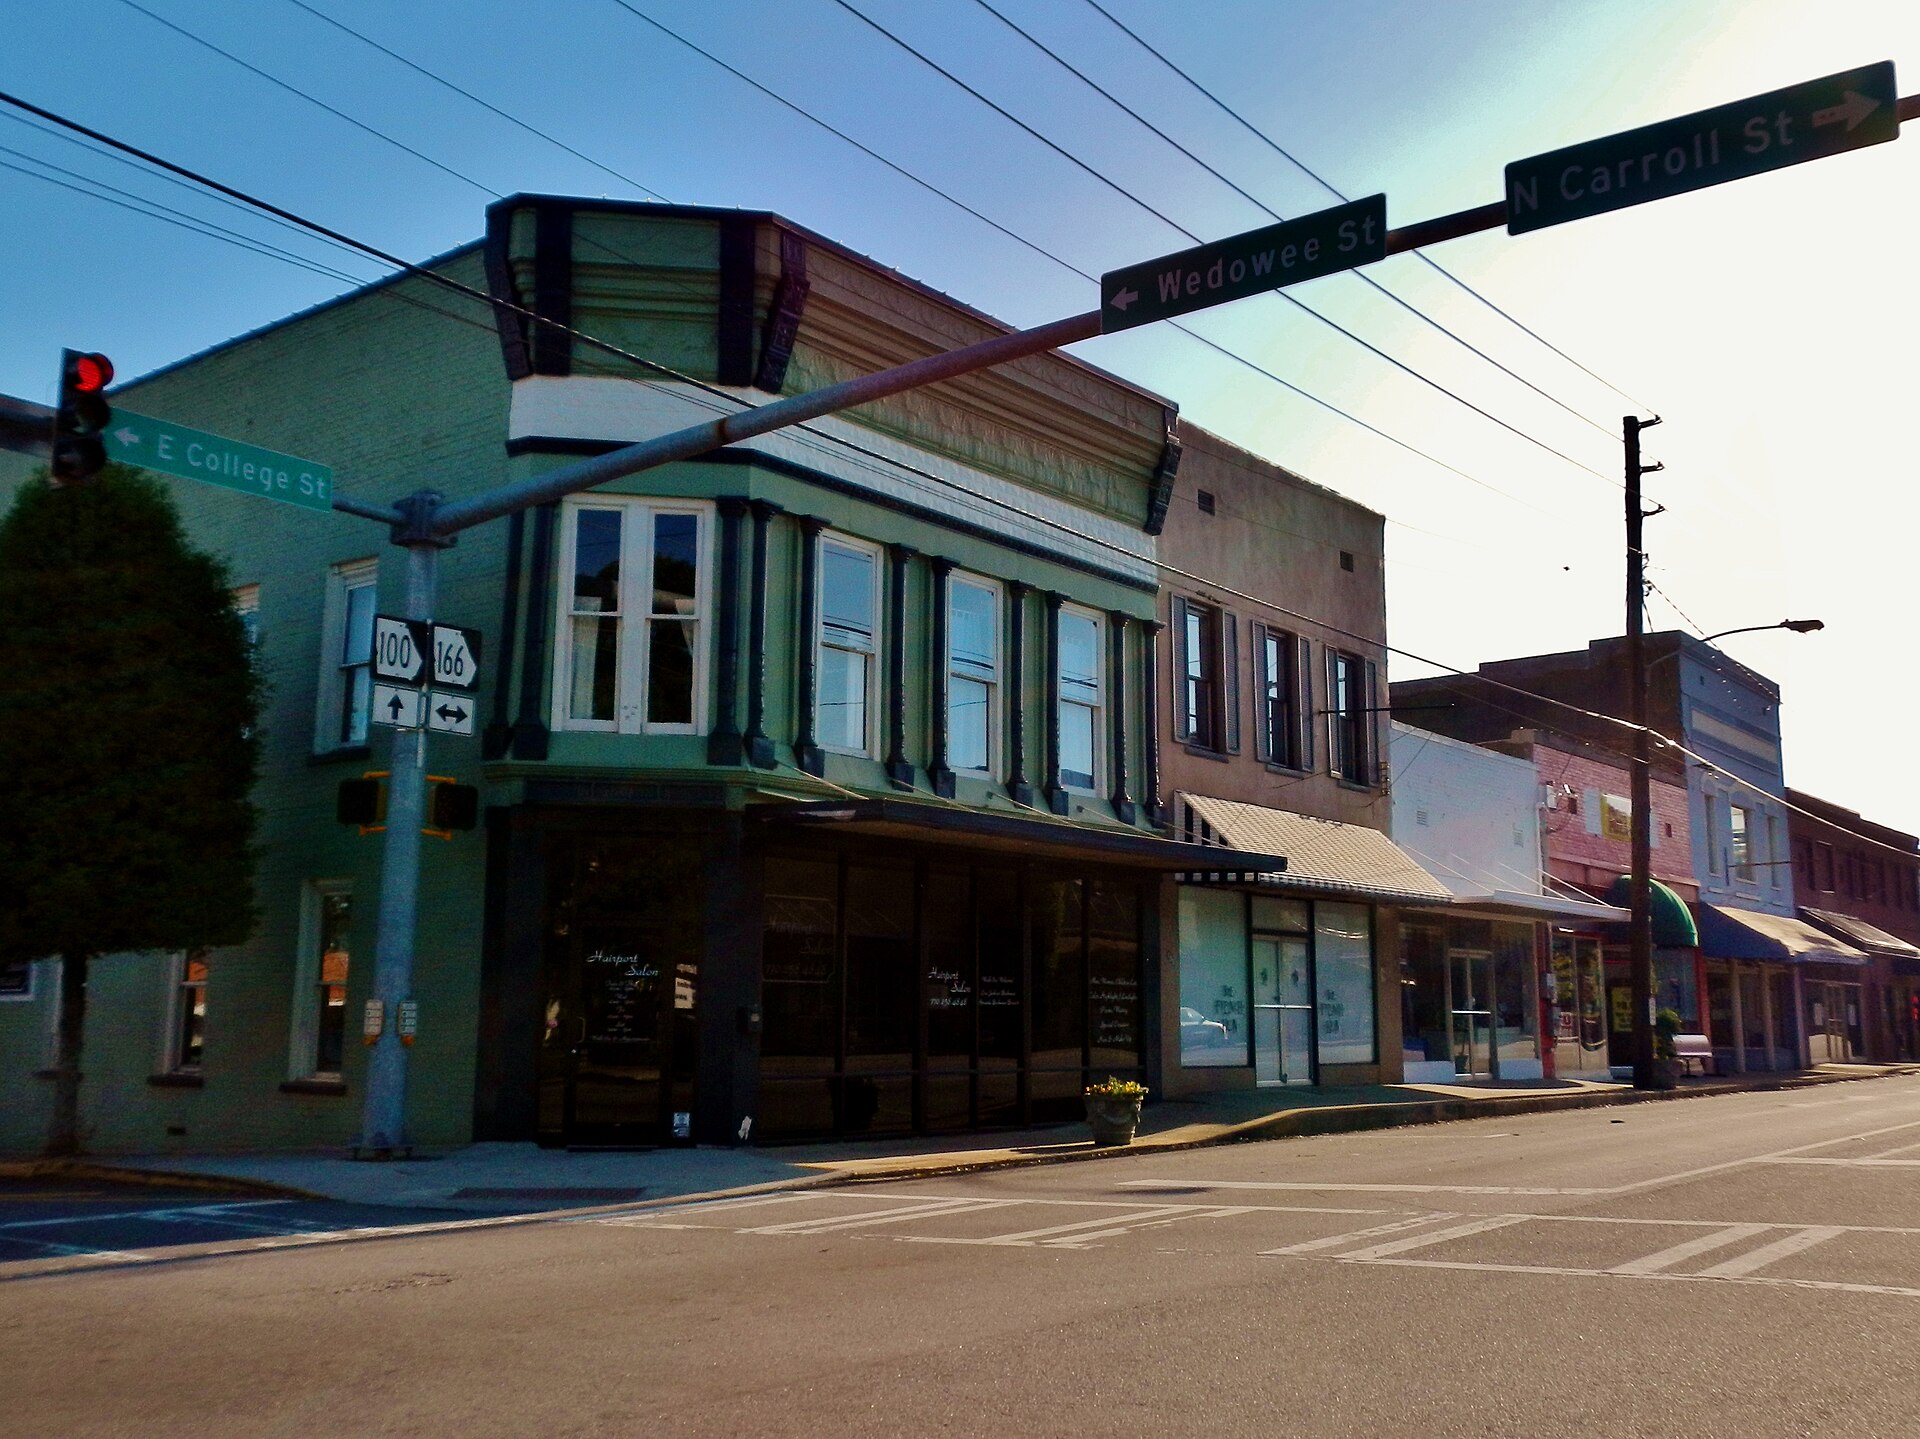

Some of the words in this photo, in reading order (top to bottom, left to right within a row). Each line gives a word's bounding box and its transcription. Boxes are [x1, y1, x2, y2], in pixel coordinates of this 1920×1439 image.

[1513, 176, 1538, 214] N
[1560, 128, 1720, 202] Carroll
[1743, 110, 1794, 154] St
[1158, 237, 1320, 303] Wedowee
[1337, 214, 1377, 252] St
[158, 434, 174, 460] E
[187, 443, 289, 491] College
[299, 473, 325, 499] St
[379, 631, 410, 668] 100
[437, 641, 464, 676] 166
[585, 950, 638, 967] Hairport
[624, 963, 659, 976] Salon
